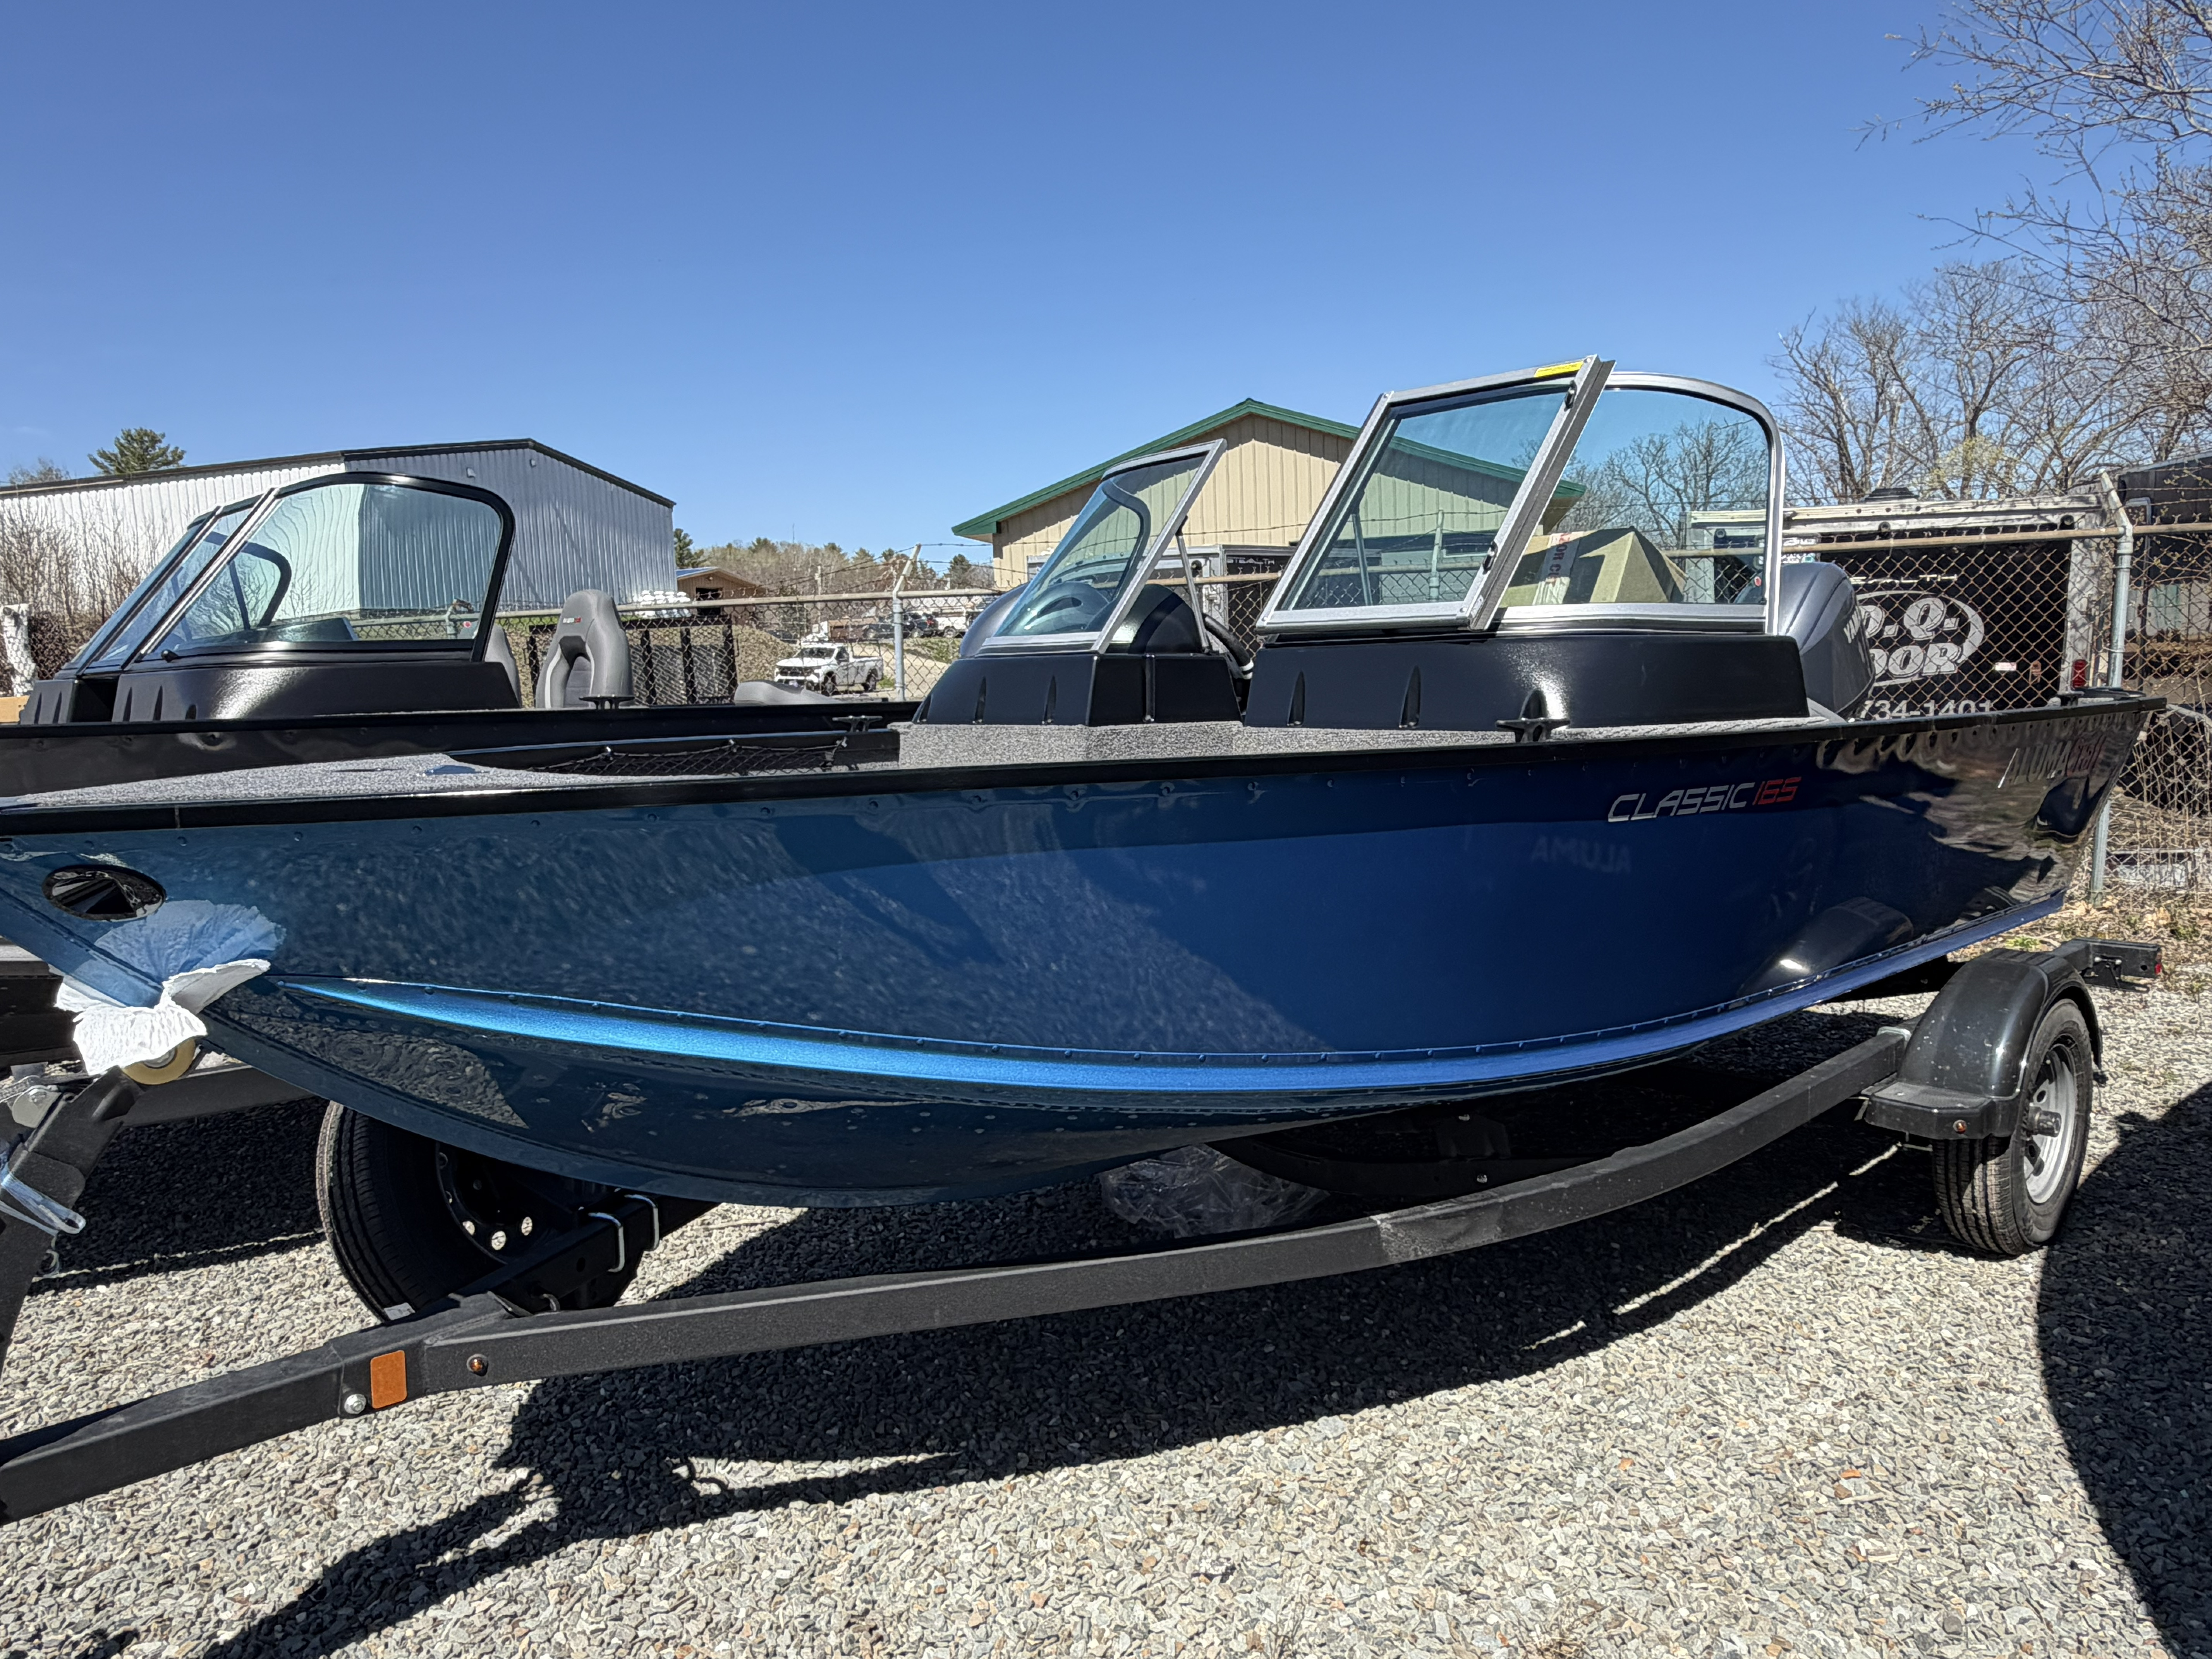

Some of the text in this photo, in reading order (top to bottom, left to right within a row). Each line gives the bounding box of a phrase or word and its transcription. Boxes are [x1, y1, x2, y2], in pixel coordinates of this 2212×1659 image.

[1850, 574, 1958, 584] EALTH
[1608, 777, 1802, 823] CLASSIC 165
